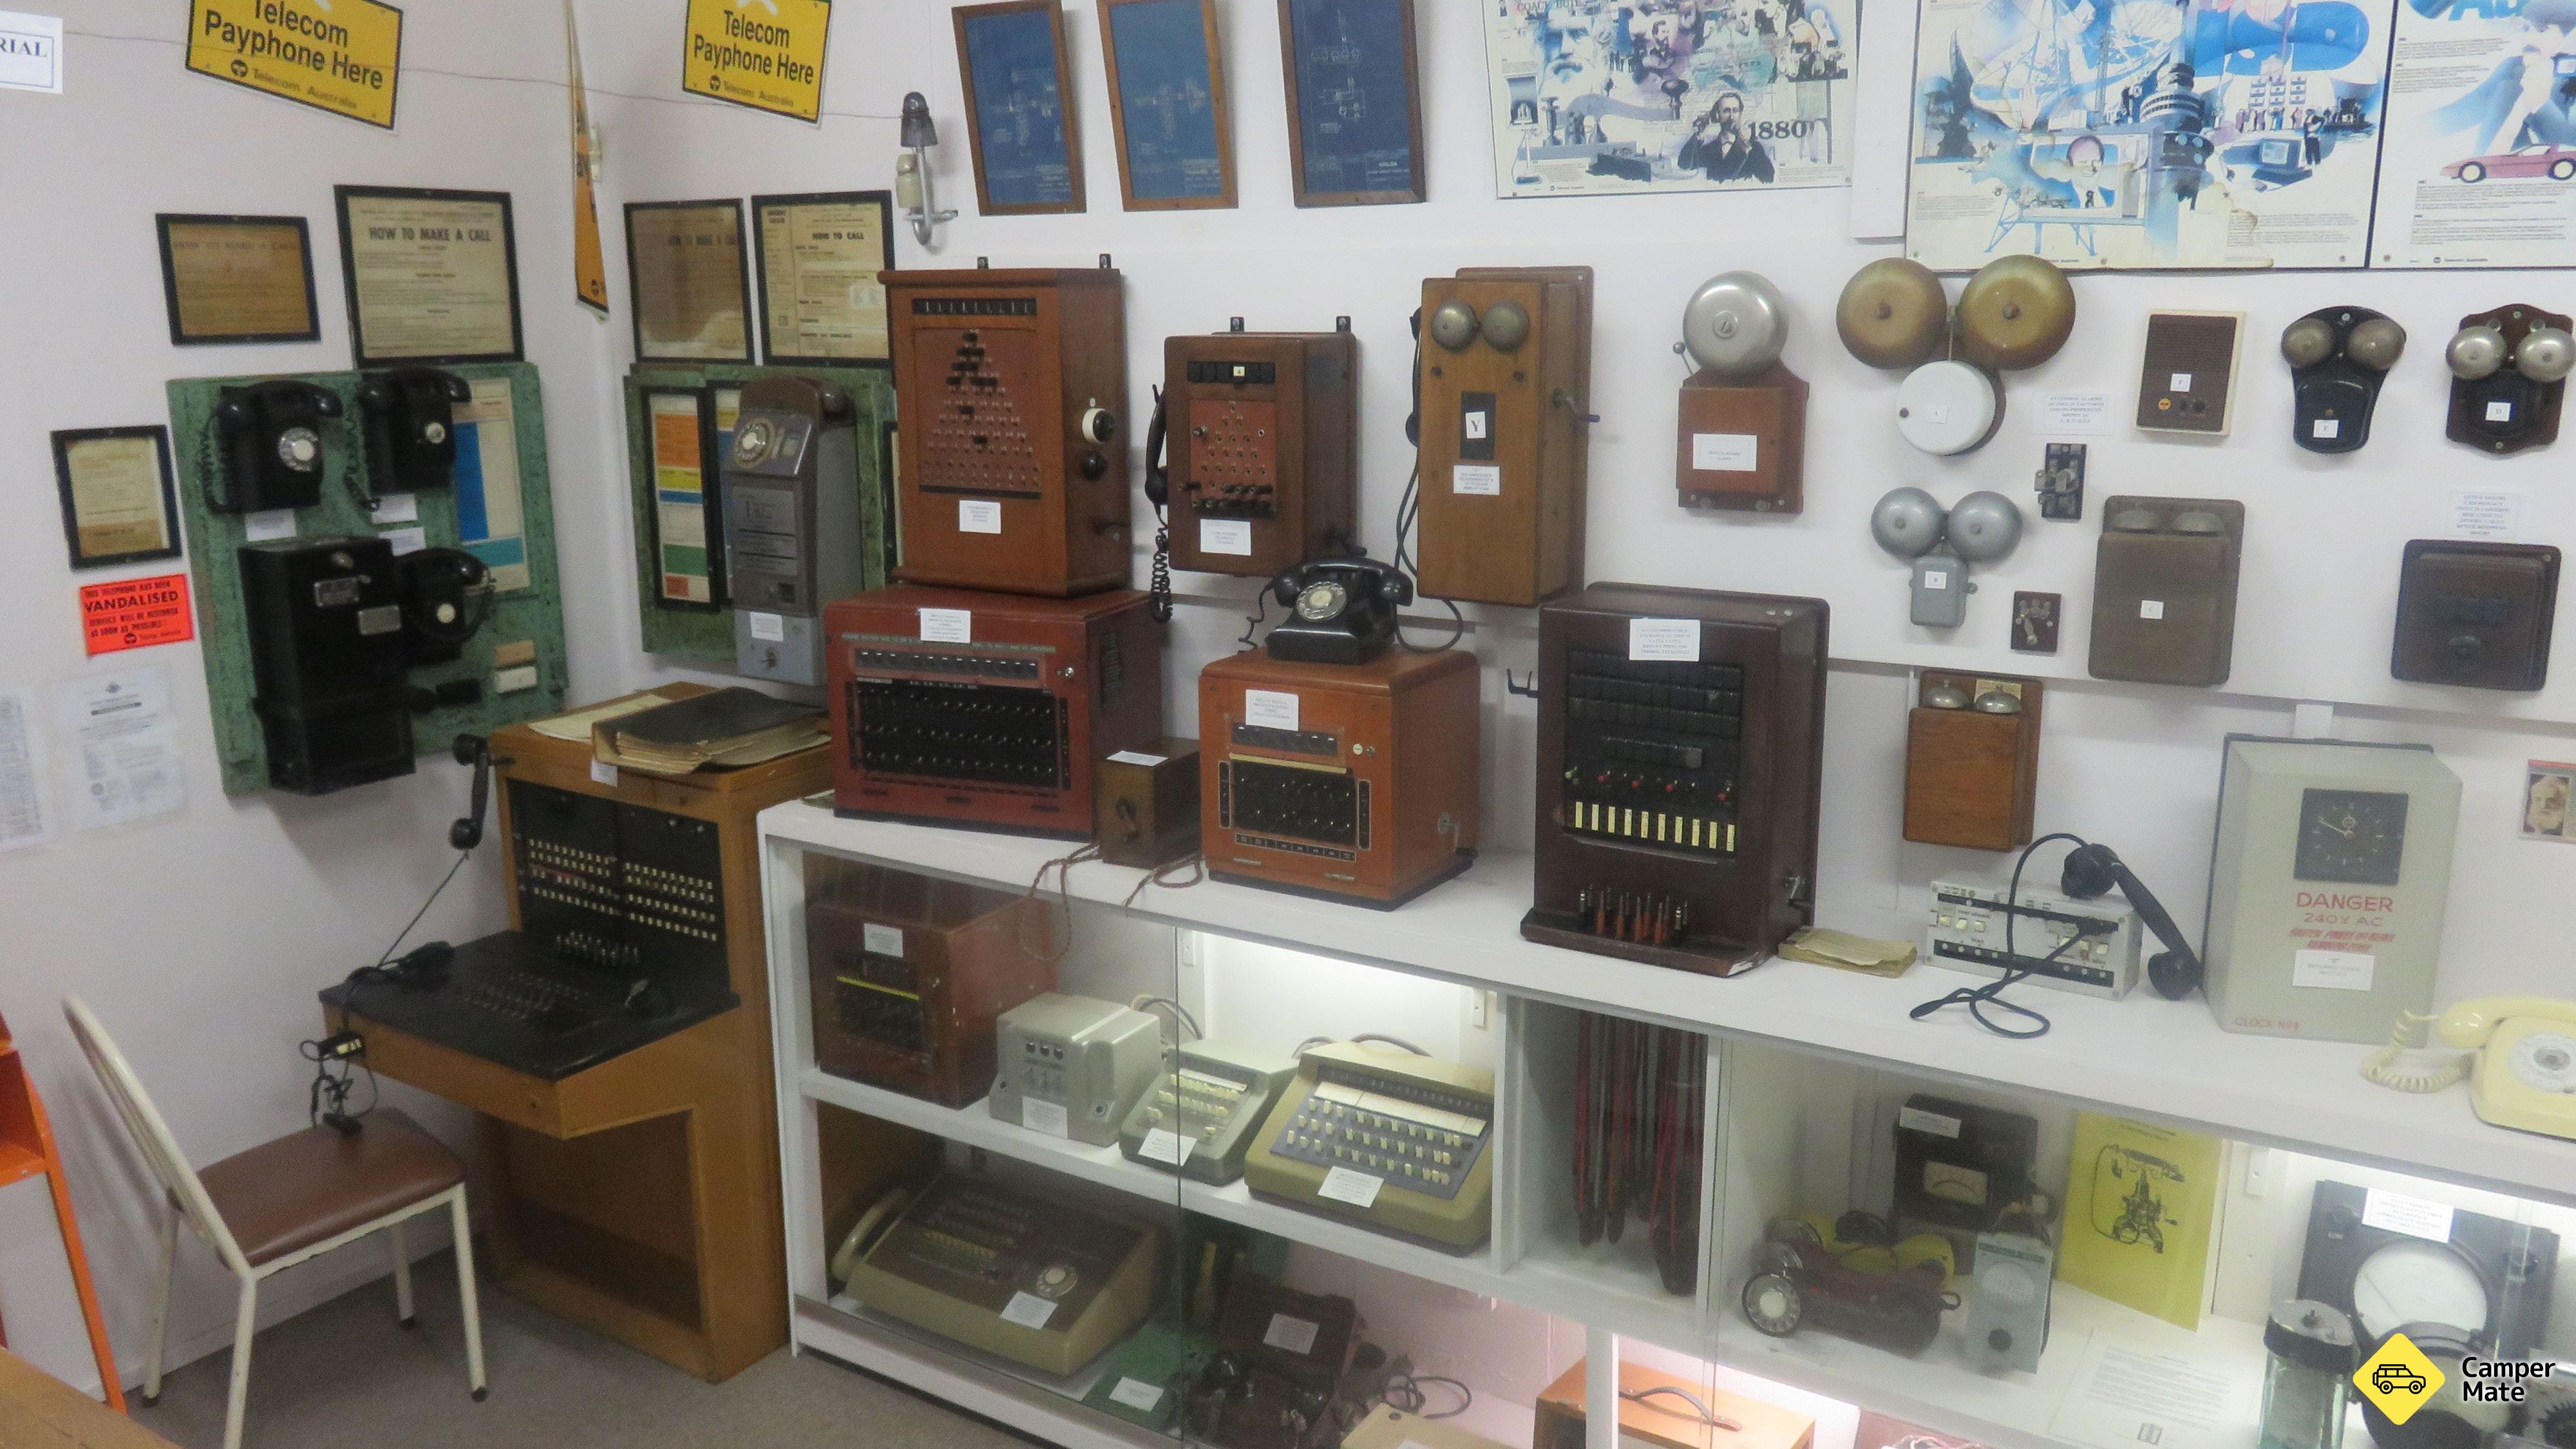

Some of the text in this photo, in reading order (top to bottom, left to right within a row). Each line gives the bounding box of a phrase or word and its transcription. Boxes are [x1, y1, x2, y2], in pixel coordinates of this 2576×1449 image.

[254, 0, 348, 48] Telecom
[724, 10, 790, 48] Telecom
[205, 8, 383, 90] Payphone Here
[694, 33, 813, 84] Payphone Here
[252, 68, 357, 109] Telecom Australia
[1748, 120, 1806, 139] 1880
[369, 227, 491, 242] HOW TO MAKE A CALL
[812, 232, 830, 242] HOW
[847, 232, 864, 242] CALL
[1471, 420, 1480, 432] Y
[84, 590, 178, 612] VANDALISED
[2297, 892, 2394, 912] DANGER
